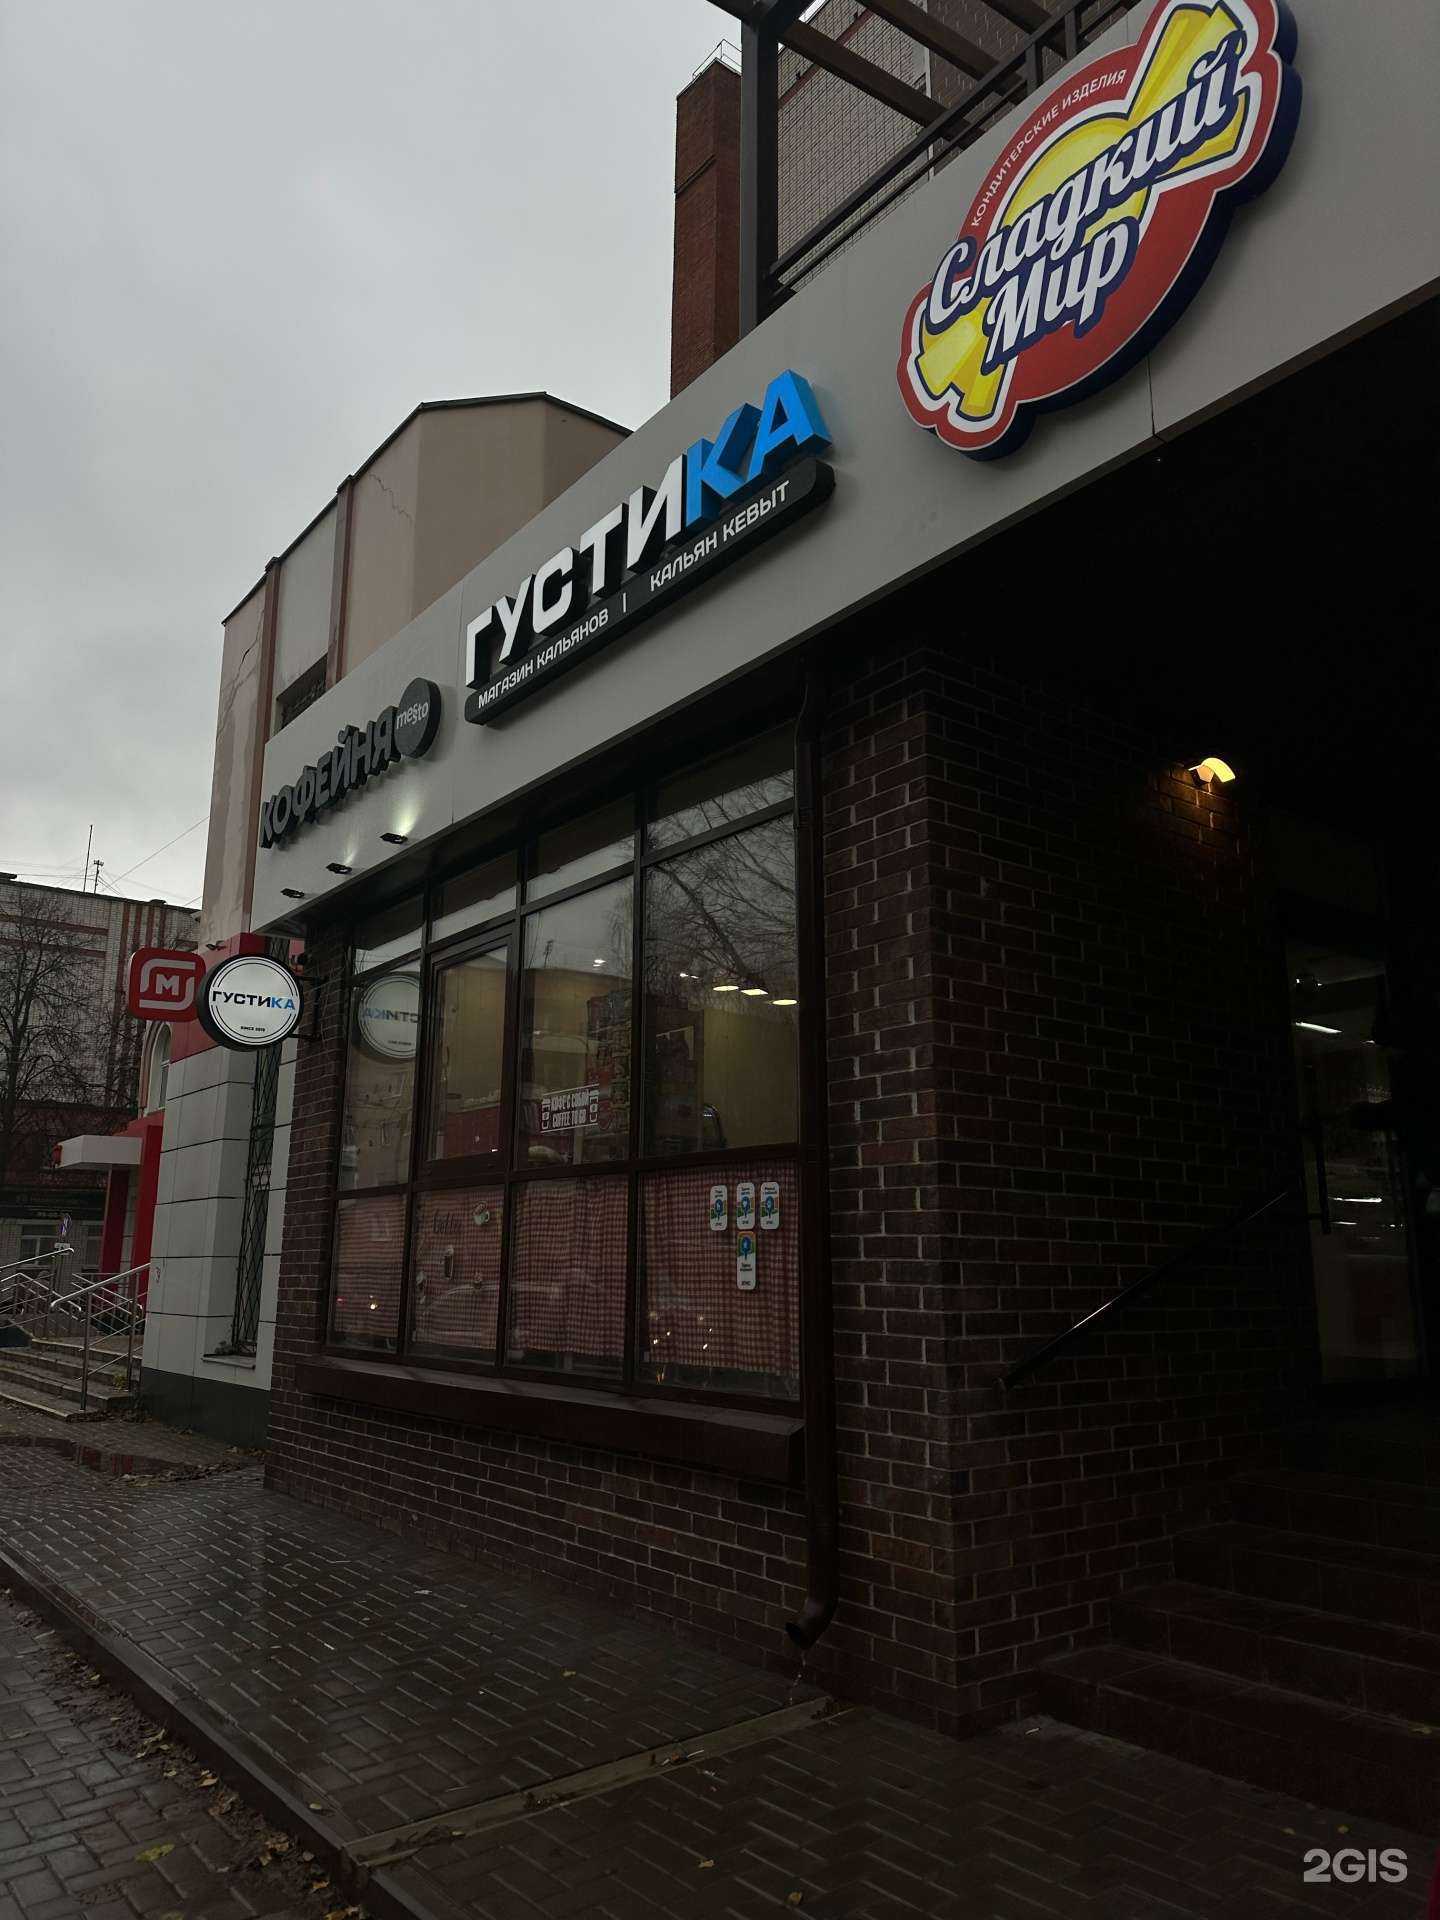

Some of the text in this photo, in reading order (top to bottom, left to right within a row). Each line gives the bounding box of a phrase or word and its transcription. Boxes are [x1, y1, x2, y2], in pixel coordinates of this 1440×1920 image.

[928, 37, 1238, 326] Сладкий
[971, 68, 1127, 227] КОНДИТЕРСКИЕ ИЗДЕЛИЯ
[985, 221, 1130, 364] Мир
[465, 369, 832, 690] ГУСТИКА
[649, 479, 789, 592] КАЛЬЯН КЕВЫТ
[477, 607, 609, 709] МАГАЗИН КАЛЬЯНОВ
[259, 705, 401, 849] КОФЕЙНЯ
[212, 990, 296, 1011] ГУСТИКА
